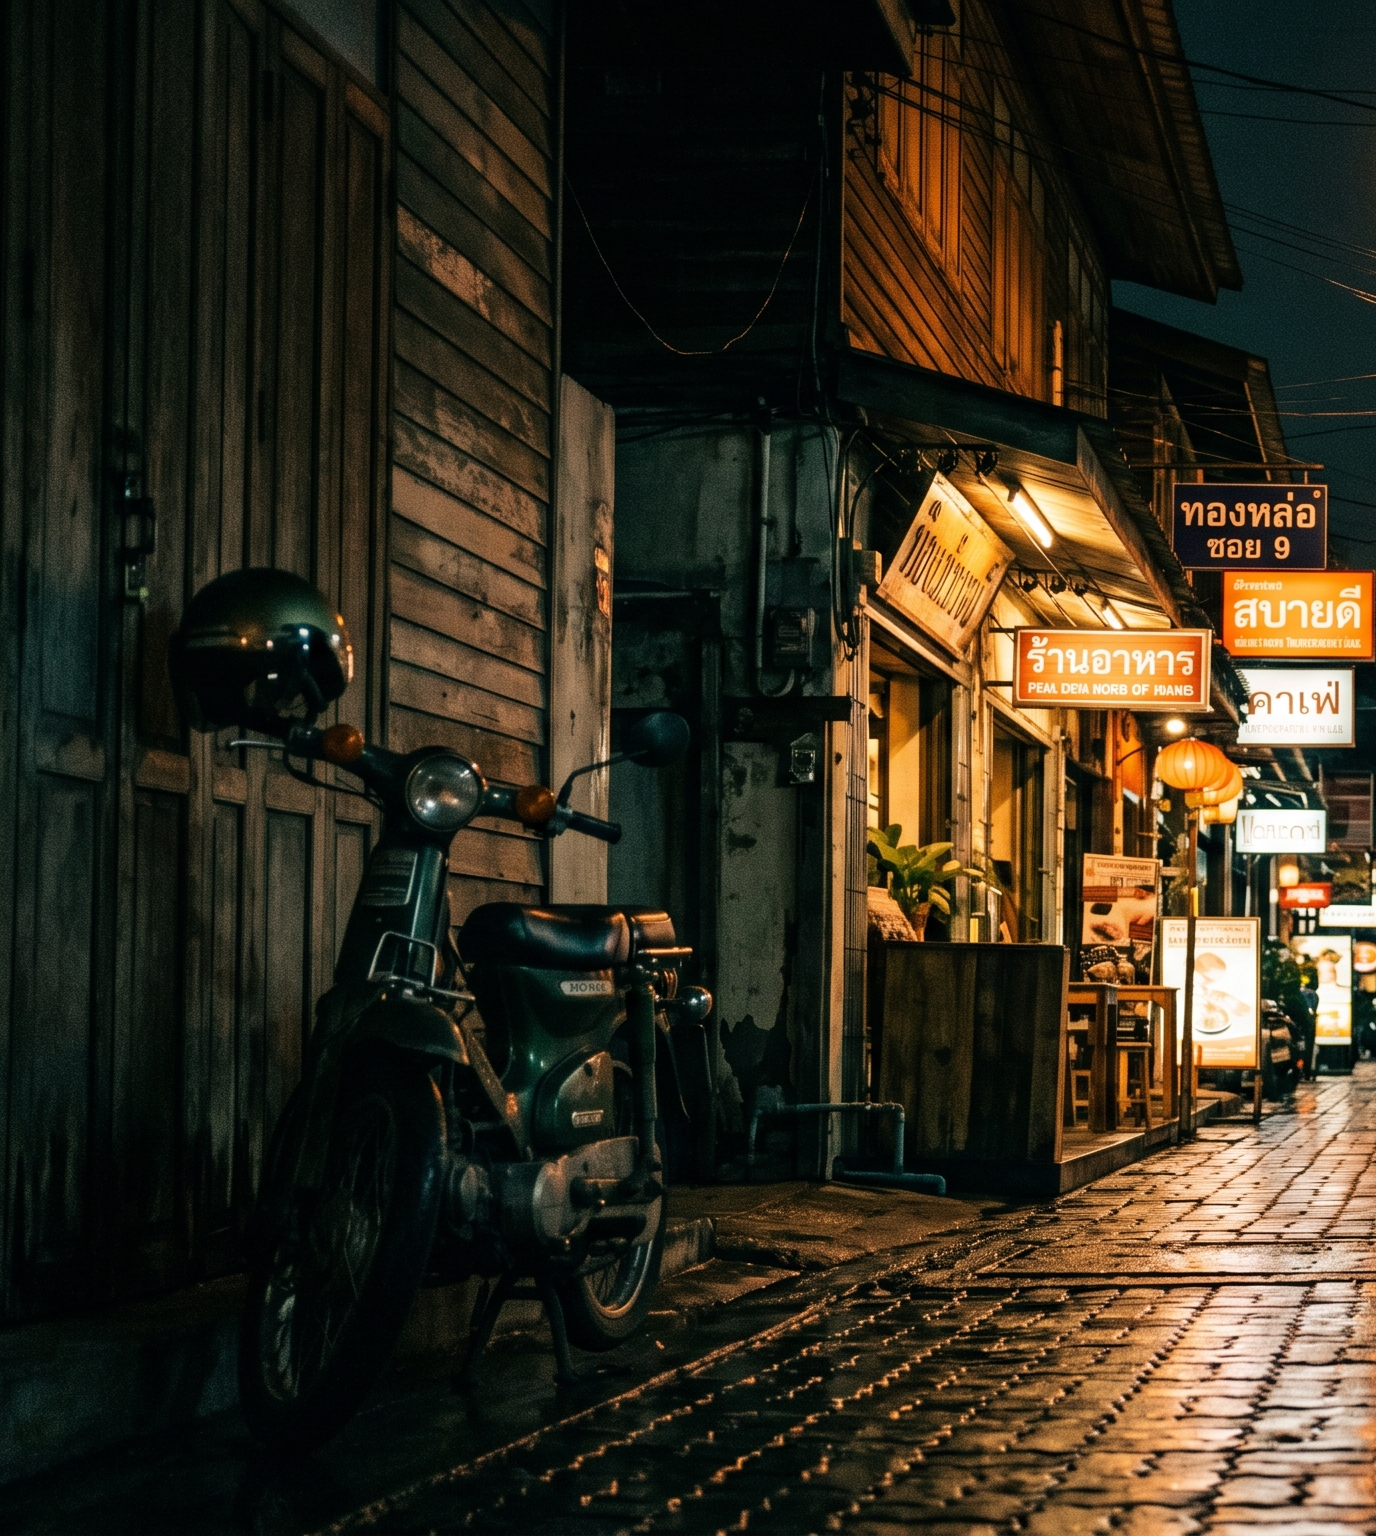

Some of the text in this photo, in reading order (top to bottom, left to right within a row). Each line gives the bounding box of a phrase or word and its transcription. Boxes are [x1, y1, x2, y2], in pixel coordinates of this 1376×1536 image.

[1206, 536, 1291, 560] ซอย 9
[1233, 584, 1362, 629] สบายดี
[1026, 635, 1196, 676] ร้านอาหาร
[1131, 683, 1150, 696] OF
[1247, 680, 1340, 715] คาเฟ่
